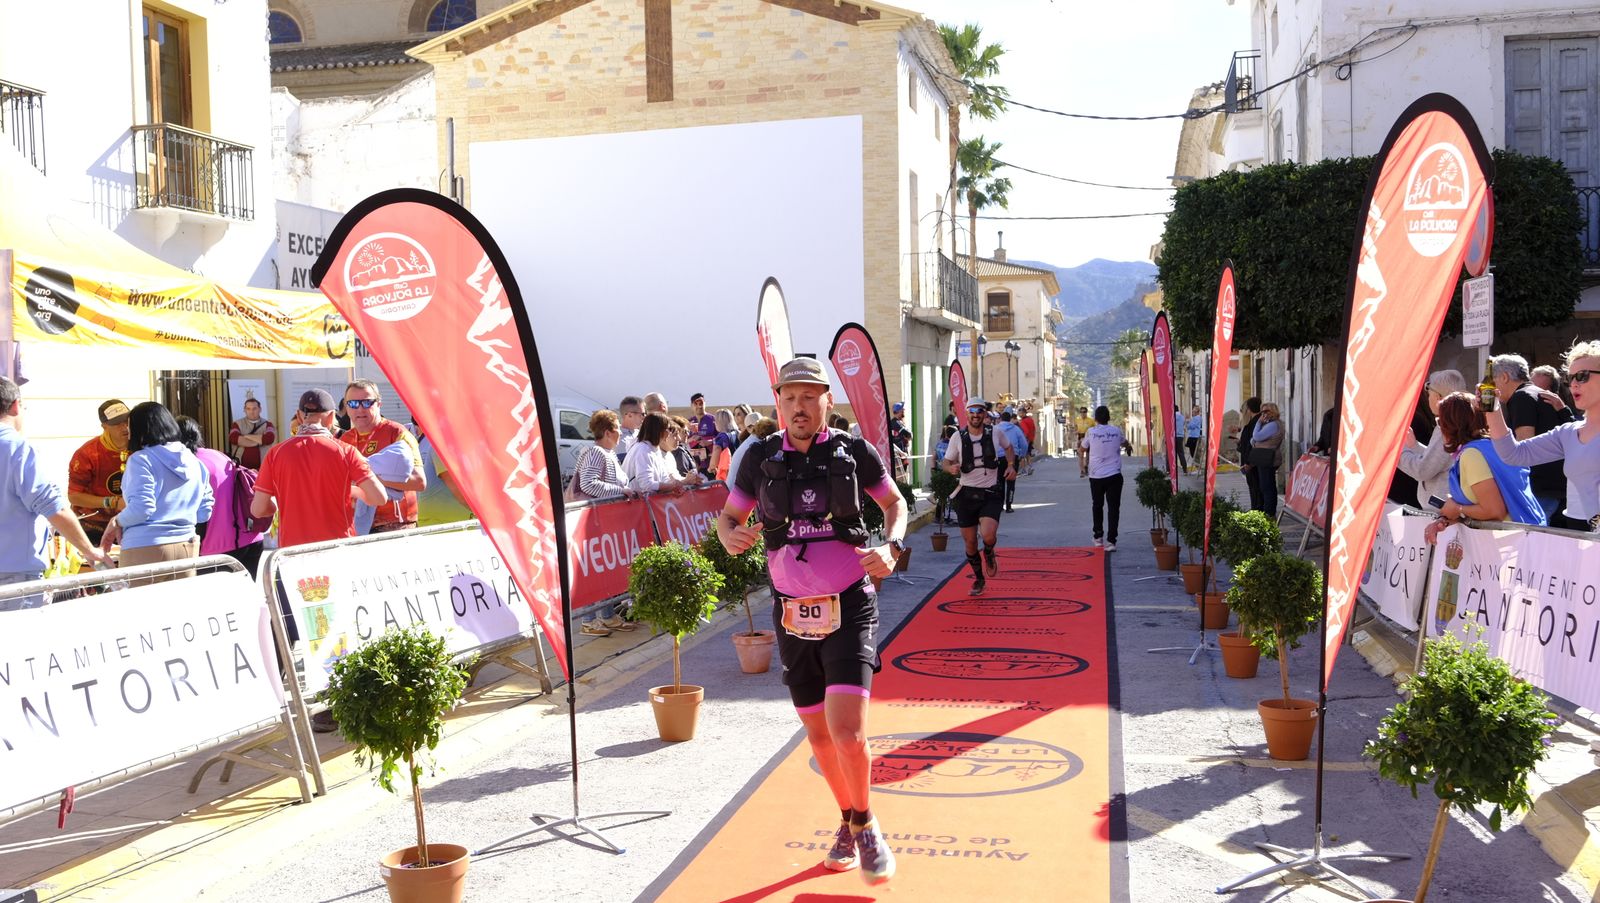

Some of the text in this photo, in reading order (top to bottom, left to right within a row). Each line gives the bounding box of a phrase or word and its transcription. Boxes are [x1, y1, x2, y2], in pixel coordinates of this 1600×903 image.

[288, 232, 327, 257] EXCE
[34, 287, 51, 296] uno
[571, 528, 641, 577] VEOLIA
[352, 559, 485, 598] AYUNTAMENTO
[356, 575, 521, 641] CANTORIA
[799, 604, 821, 618] 90
[208, 611, 239, 637] DE
[2, 642, 257, 751] NTORIA
[785, 841, 1029, 862] Ayuntanto
[969, 837, 1011, 846] de
